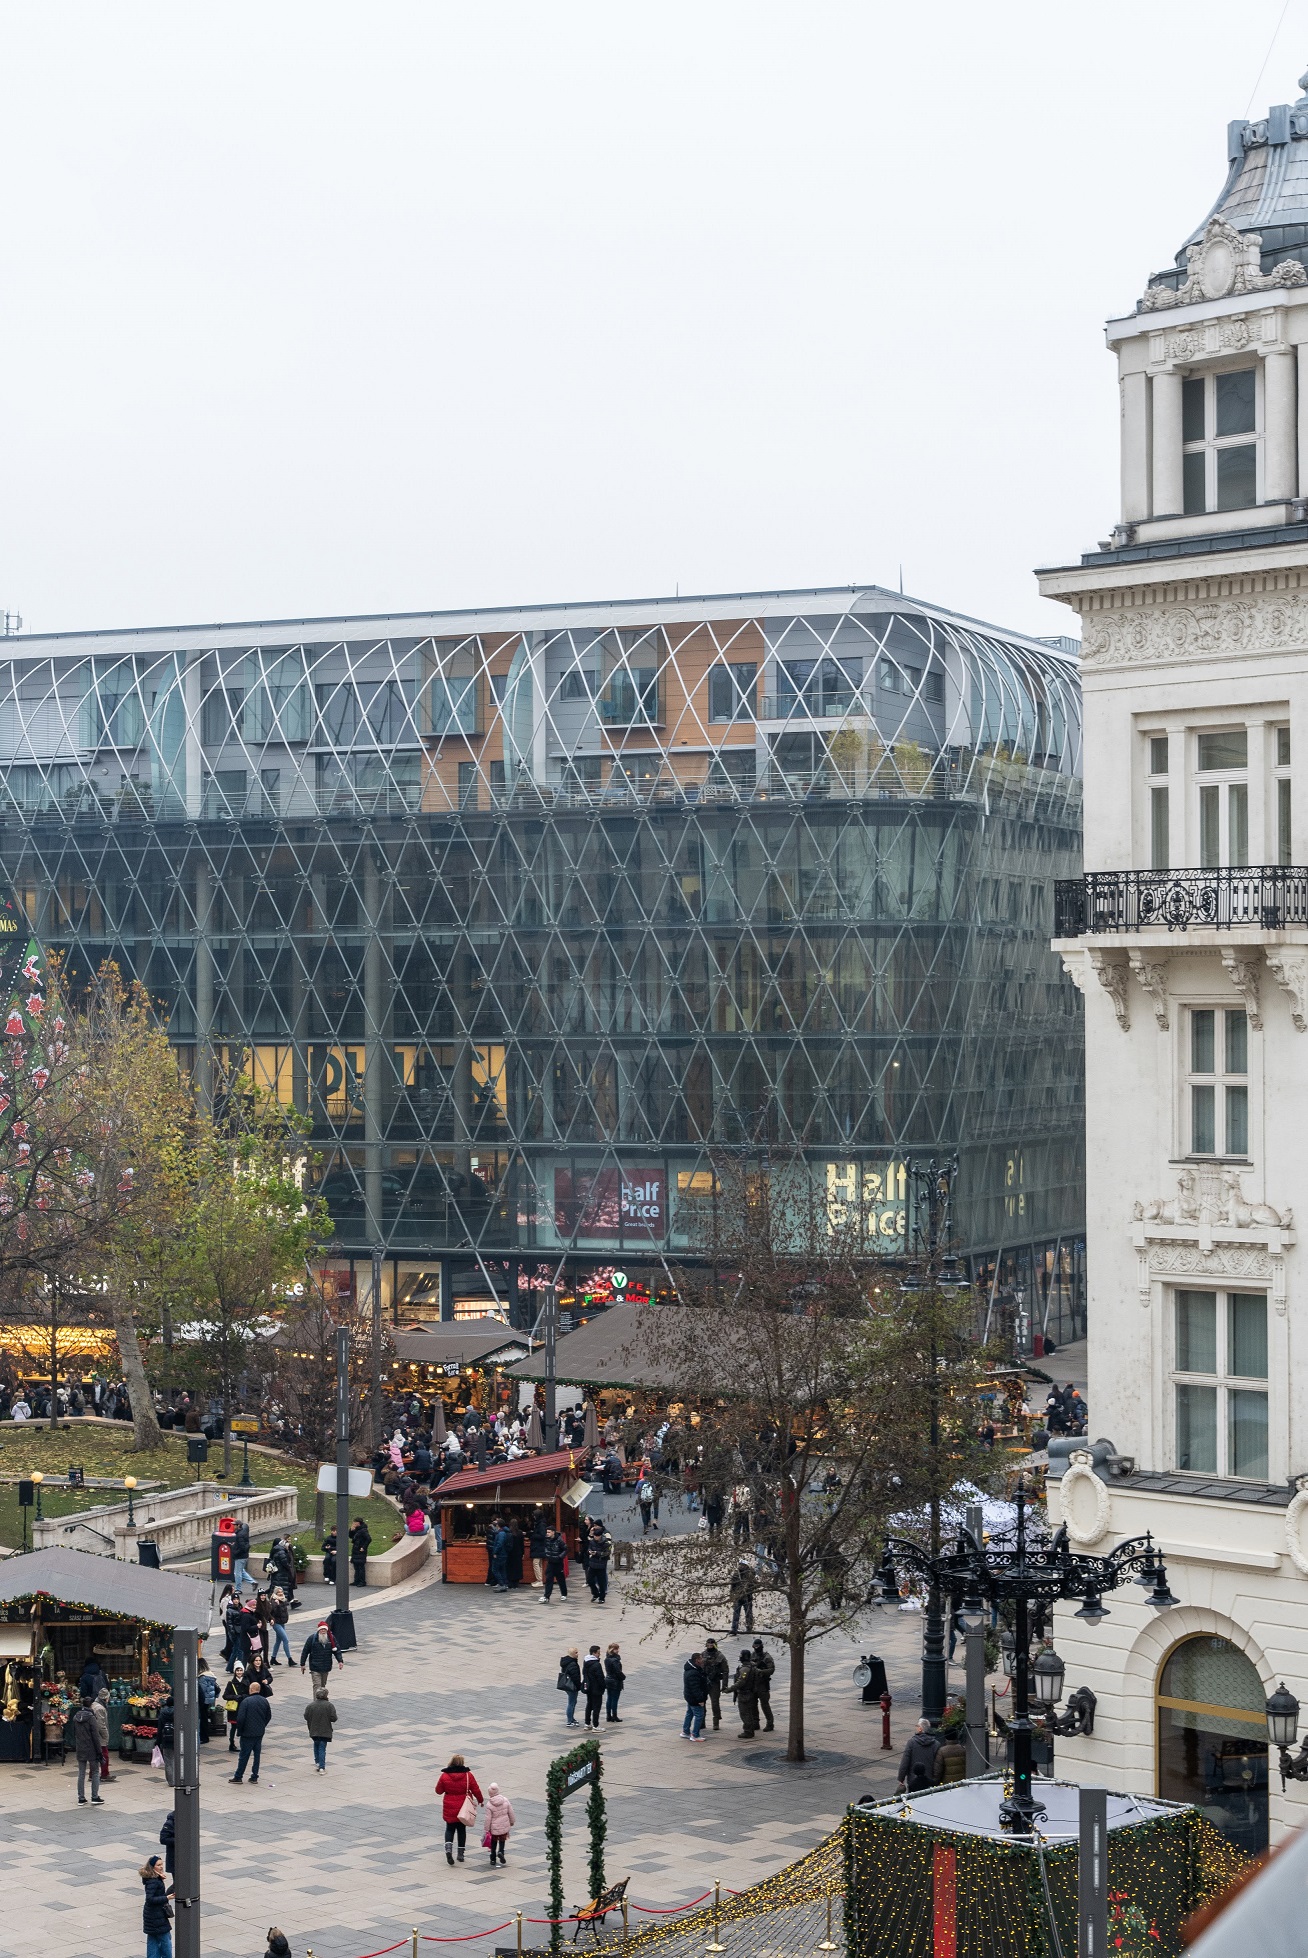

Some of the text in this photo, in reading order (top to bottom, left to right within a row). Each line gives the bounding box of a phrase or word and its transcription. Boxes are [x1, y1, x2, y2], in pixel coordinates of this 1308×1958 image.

[621, 1181, 660, 1201] Half
[584, 1293, 656, 1306] PIZZA & MORE
